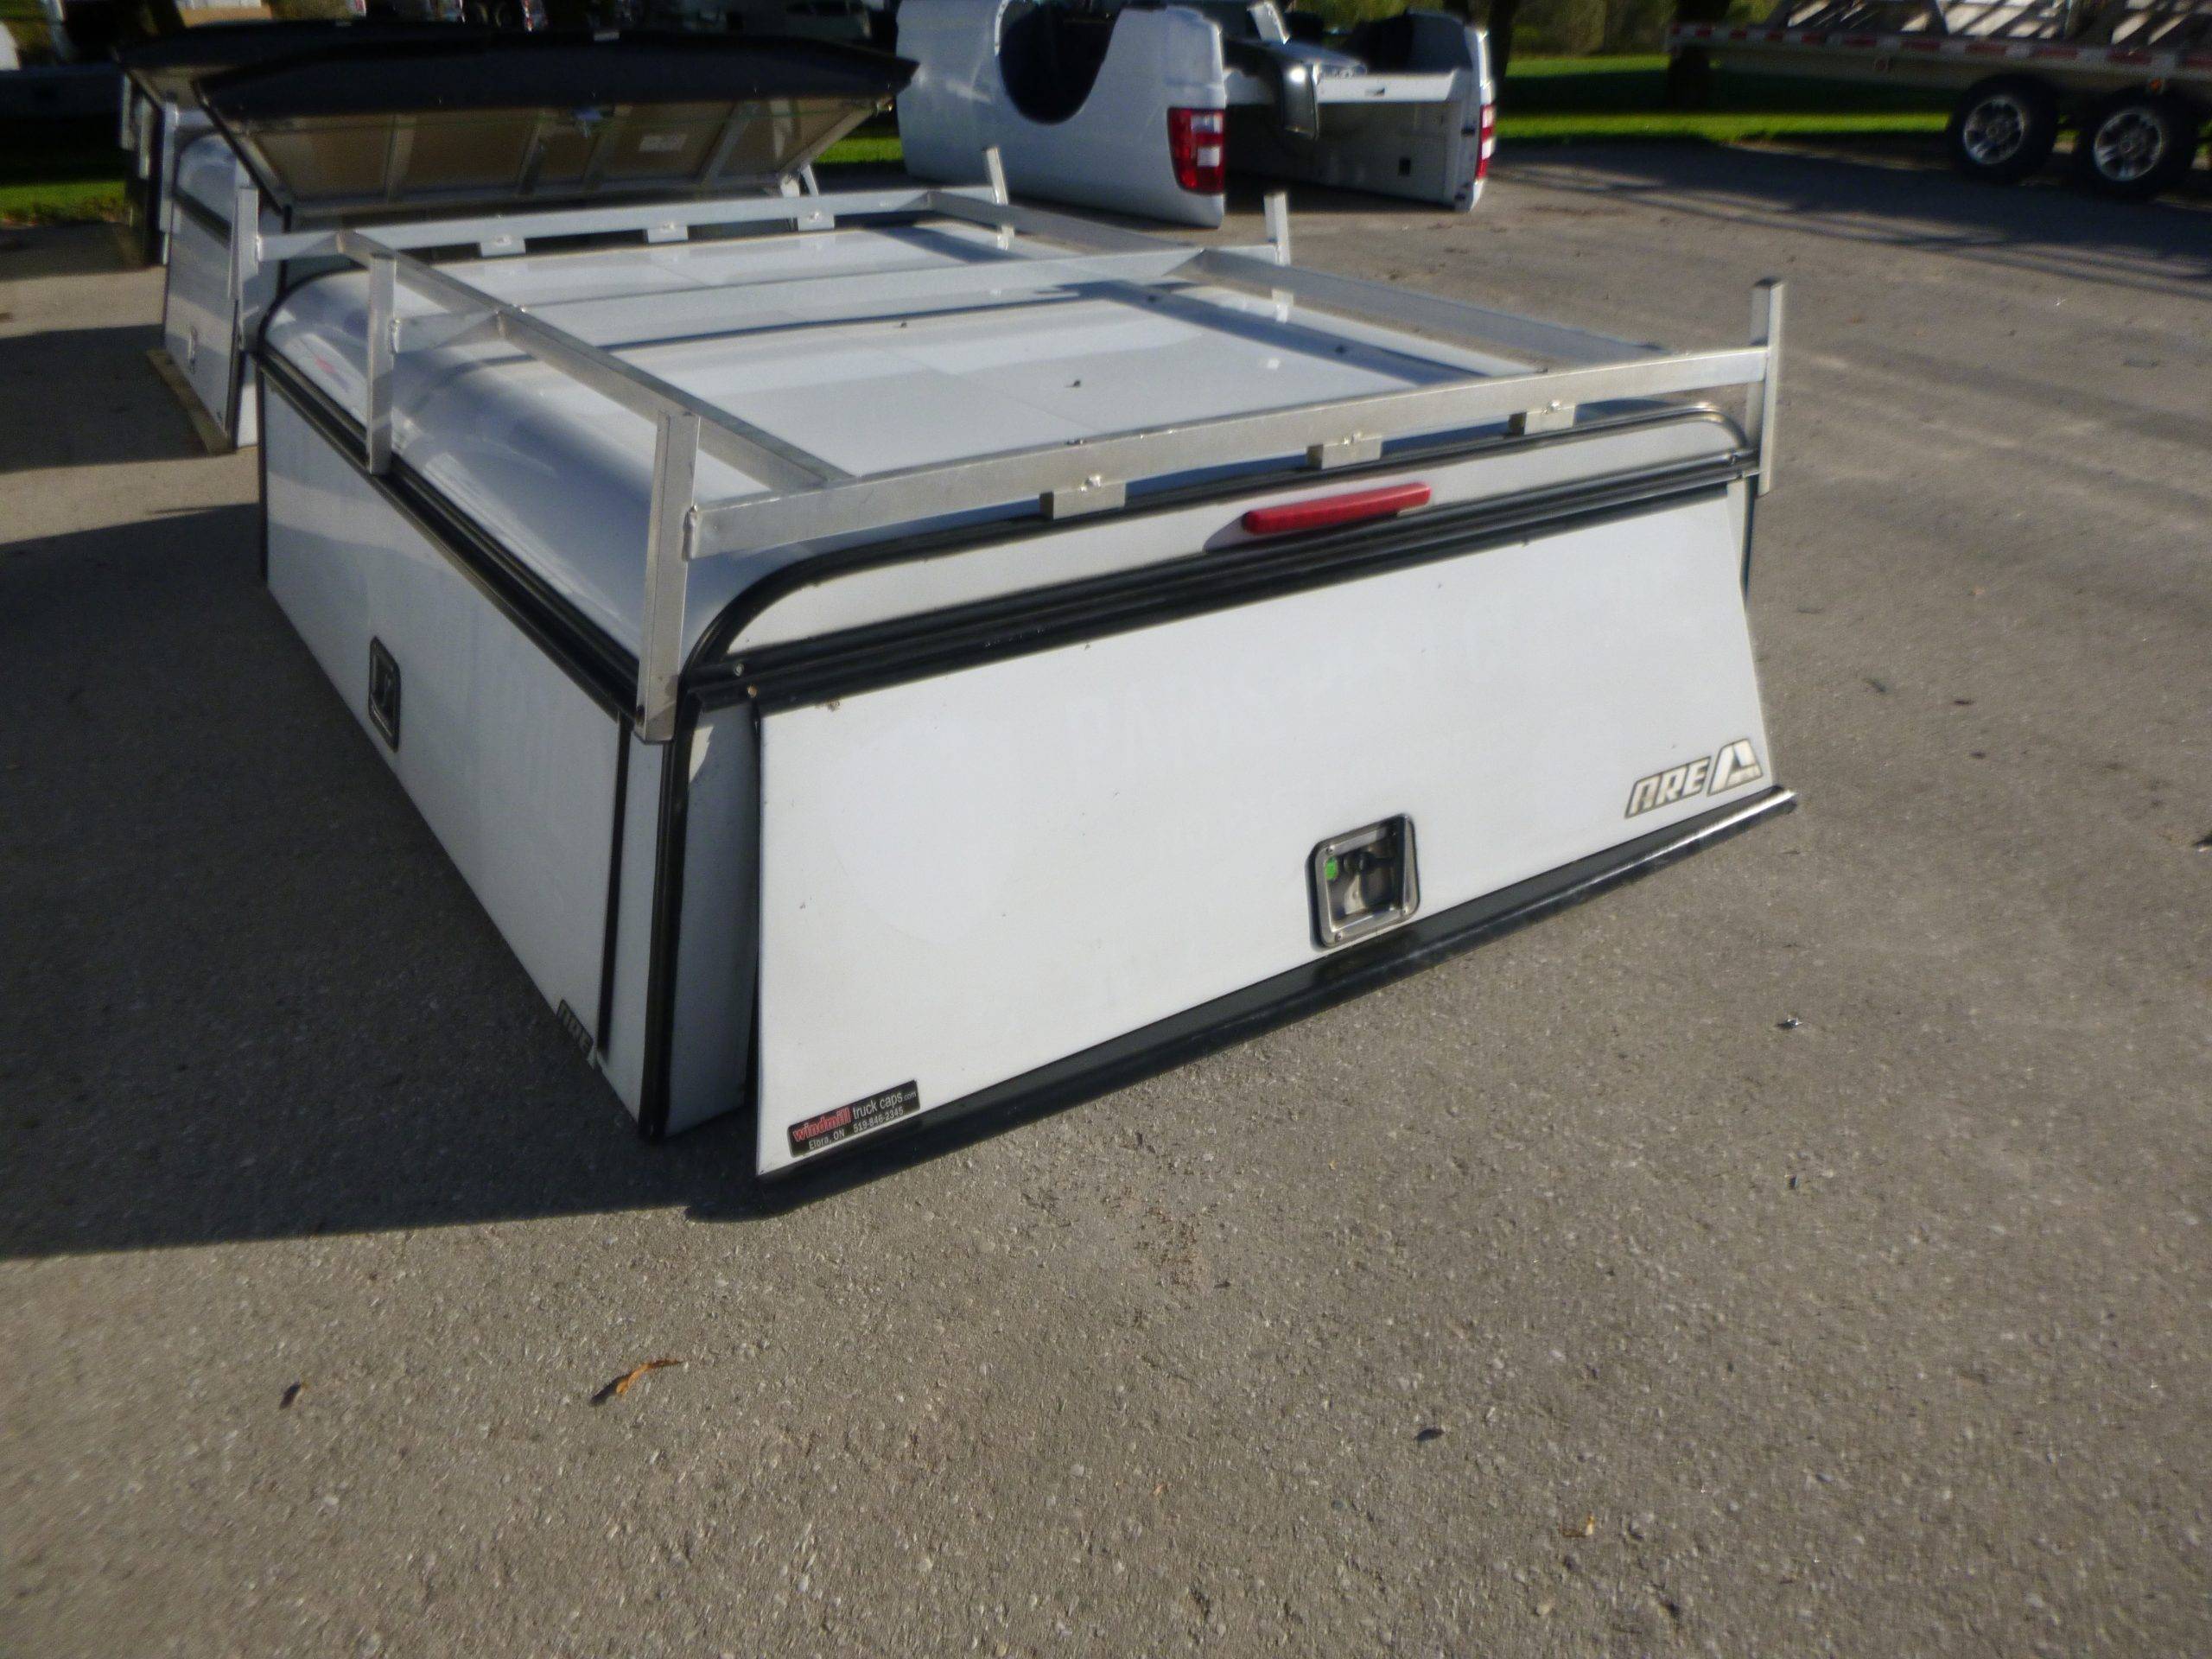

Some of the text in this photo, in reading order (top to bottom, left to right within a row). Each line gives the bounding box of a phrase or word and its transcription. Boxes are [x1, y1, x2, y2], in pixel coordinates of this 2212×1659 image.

[1624, 756, 1711, 818] ARE
[792, 1107, 851, 1142] windmill
[853, 1100, 877, 1120] truck
[833, 1128, 845, 1141] ON
